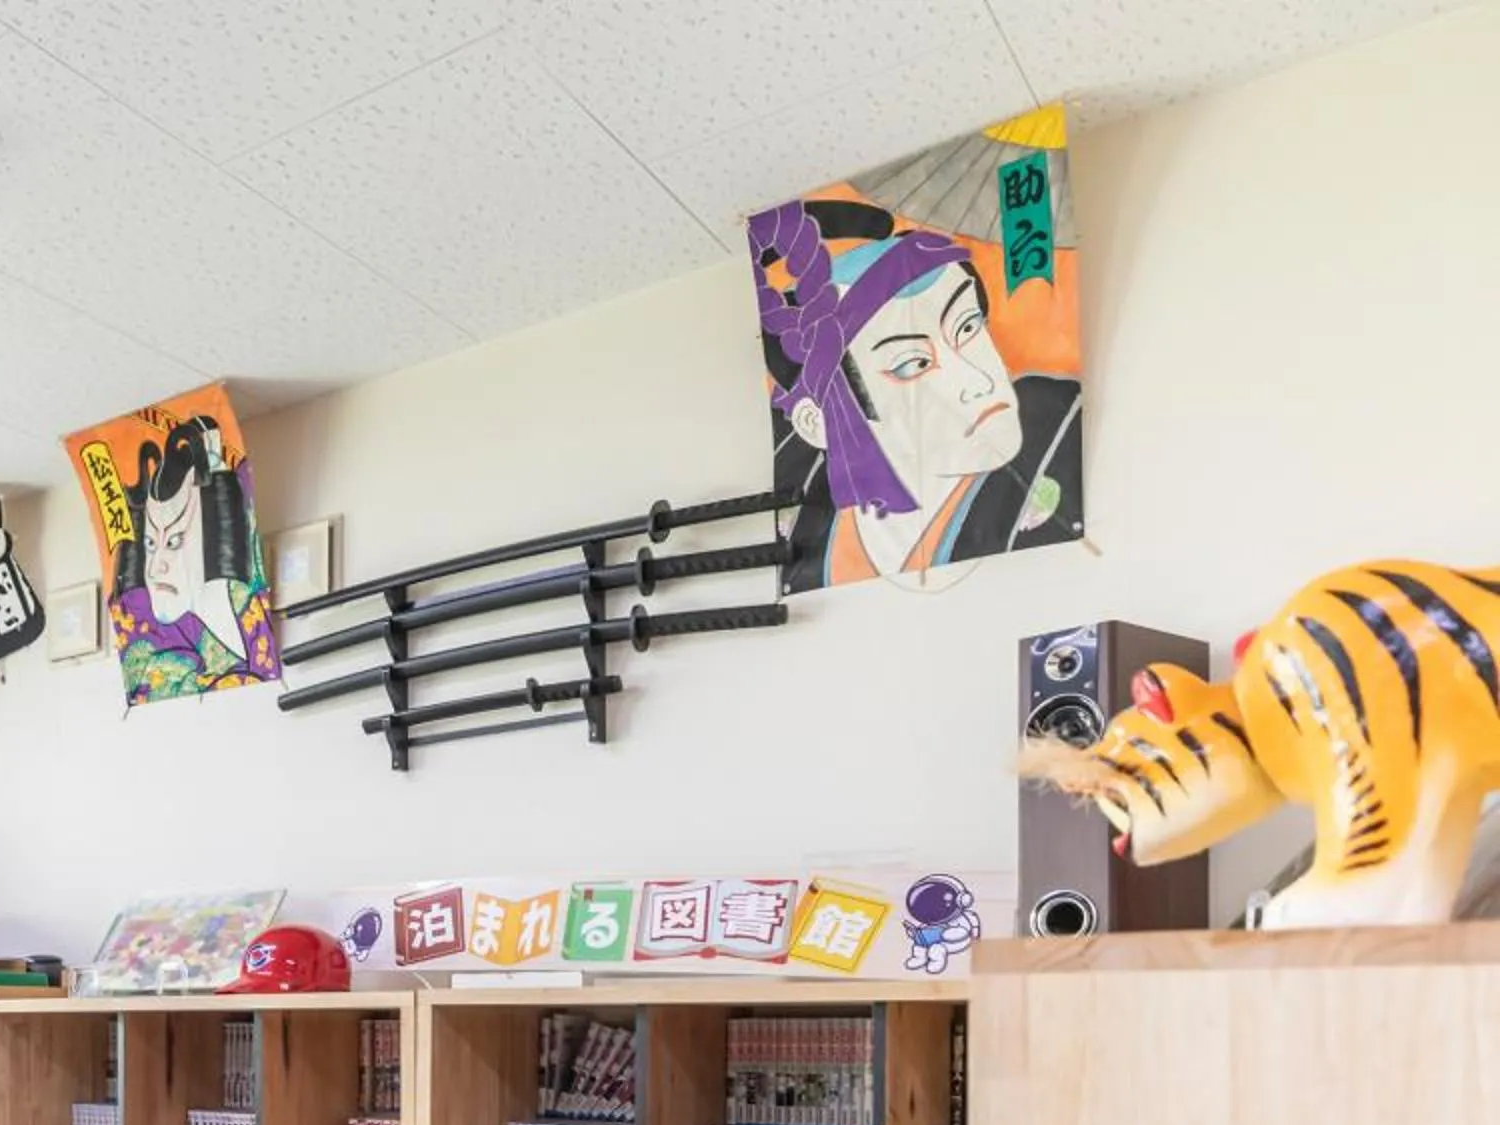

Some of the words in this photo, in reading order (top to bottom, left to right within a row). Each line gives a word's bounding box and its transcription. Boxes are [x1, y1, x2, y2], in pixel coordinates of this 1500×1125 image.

[1003, 165, 1048, 276] 助六
[88, 452, 131, 534] 松王丸
[407, 884, 873, 959] 泊まれる図書館
